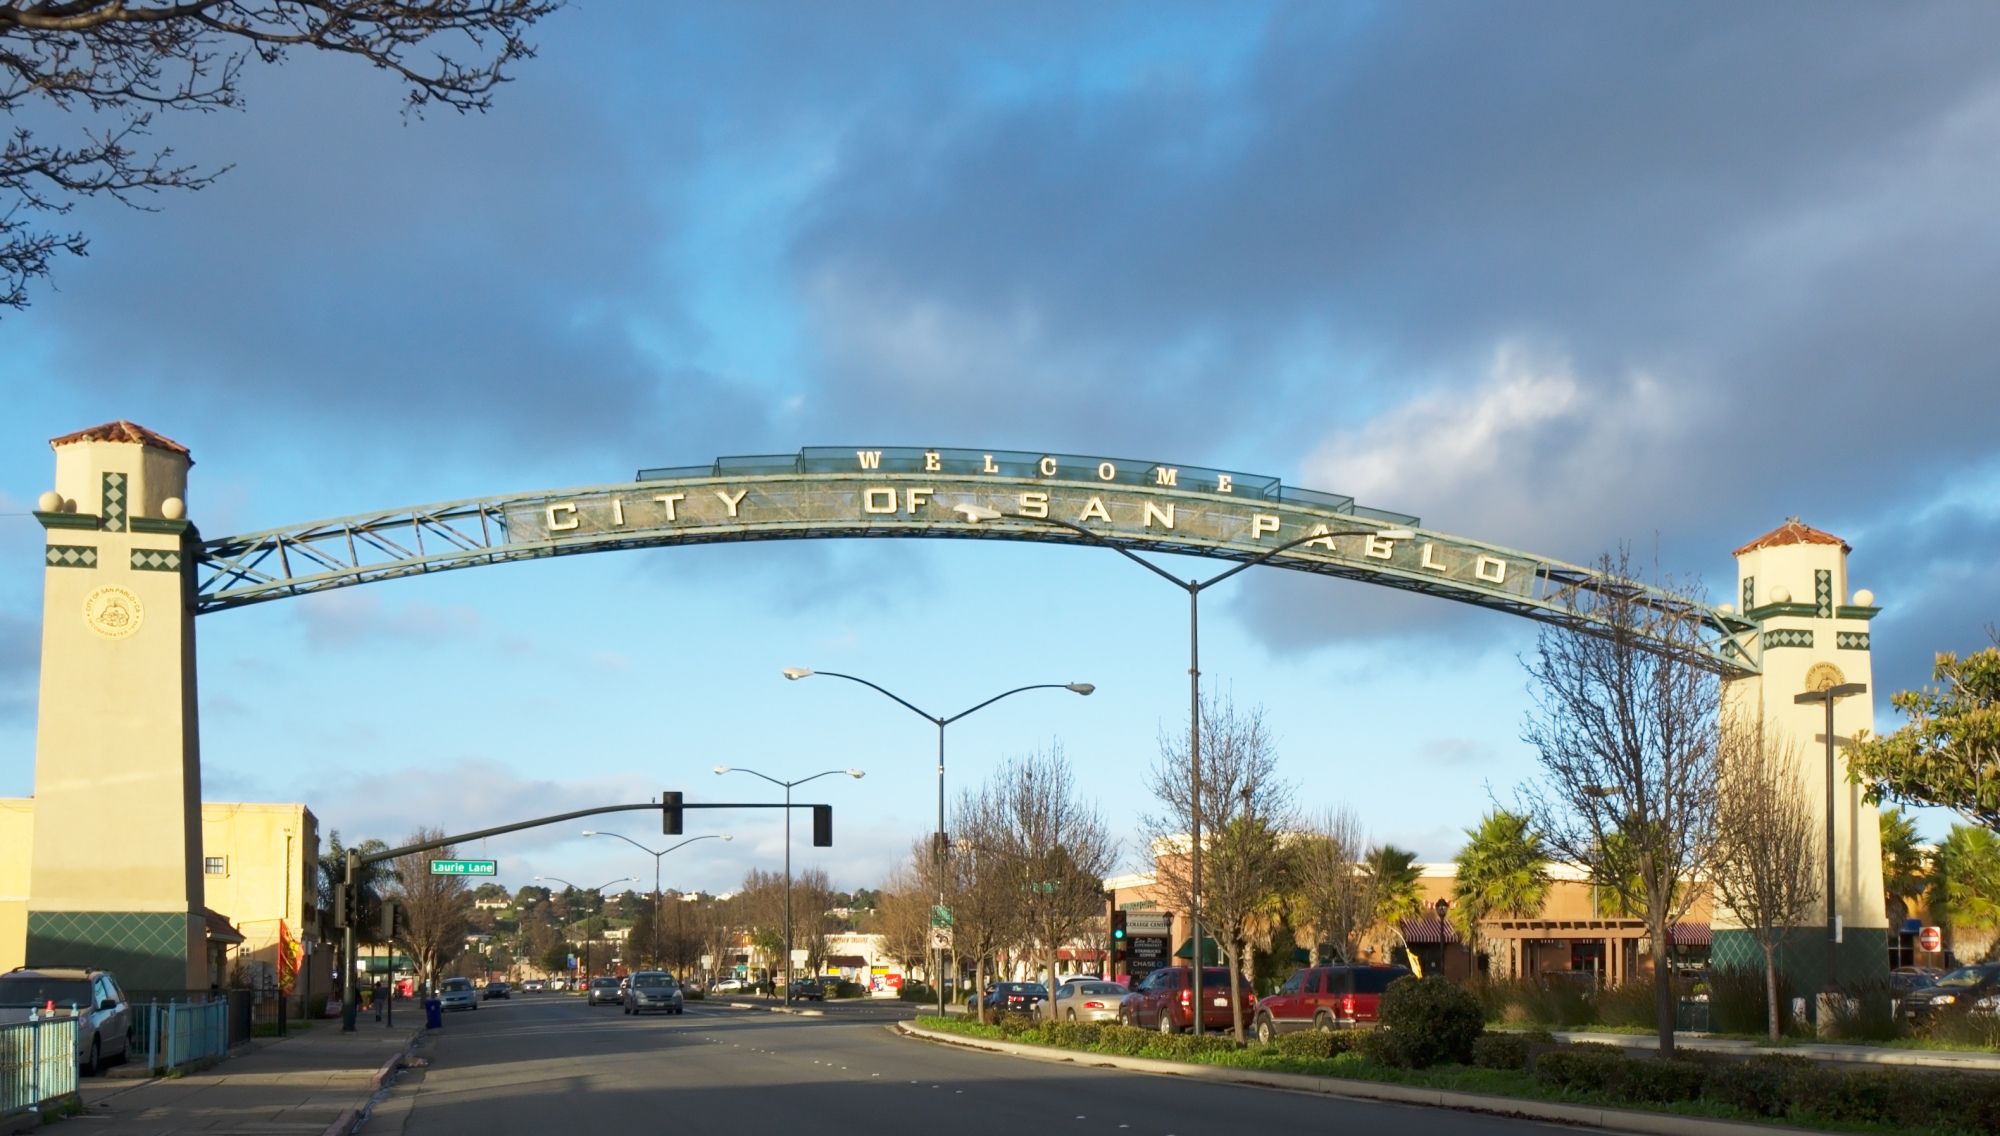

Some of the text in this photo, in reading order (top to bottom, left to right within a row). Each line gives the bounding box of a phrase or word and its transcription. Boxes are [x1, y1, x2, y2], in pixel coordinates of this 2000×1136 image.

[857, 450, 1232, 493] WELCOME
[546, 487, 1506, 584] CITY OF SAN PABLO
[433, 863, 493, 872] Laurie Lane
[886, 977, 899, 985] KFC
